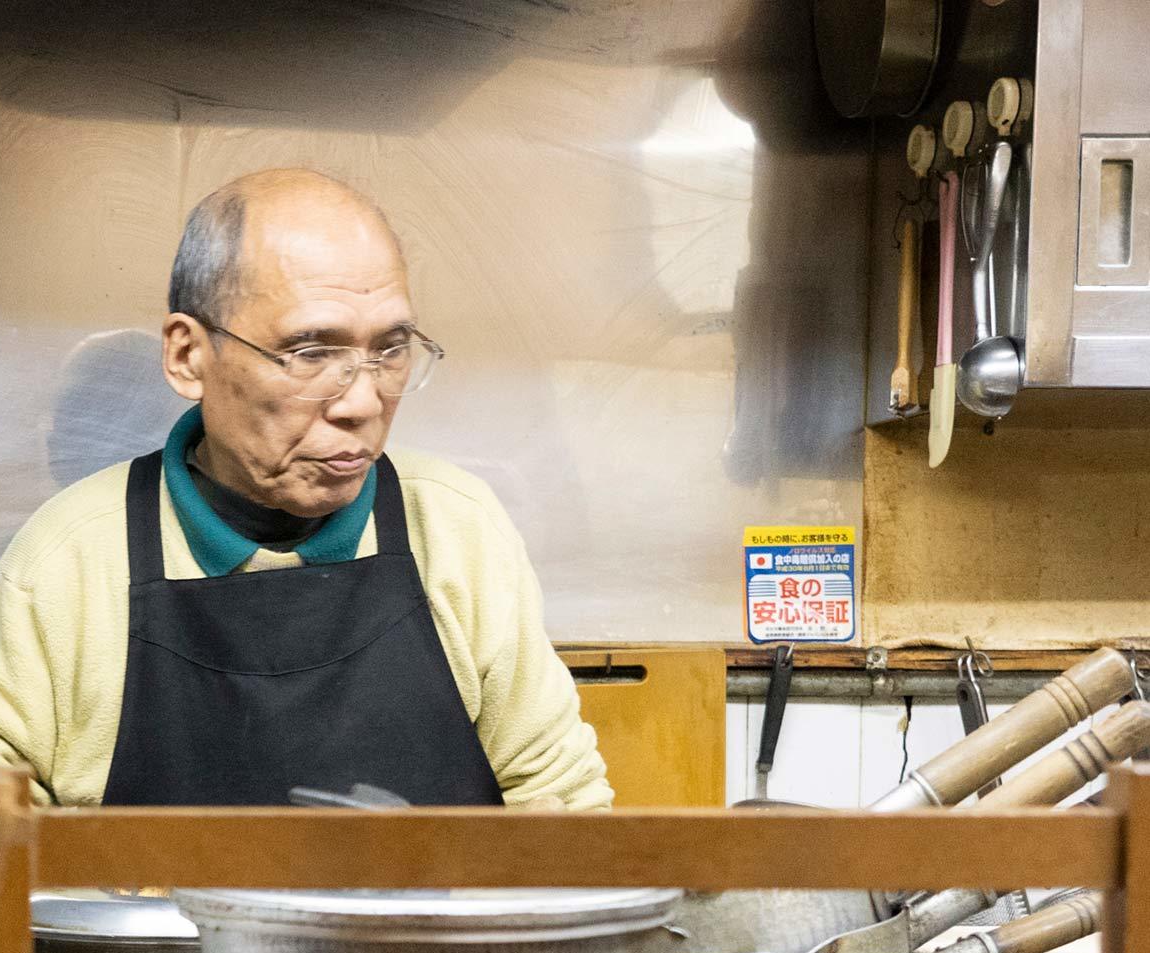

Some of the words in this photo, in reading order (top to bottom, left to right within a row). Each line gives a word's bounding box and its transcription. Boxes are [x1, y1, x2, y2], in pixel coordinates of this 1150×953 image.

[778, 577, 822, 599] 食の
[753, 600, 850, 625] 安心保証
